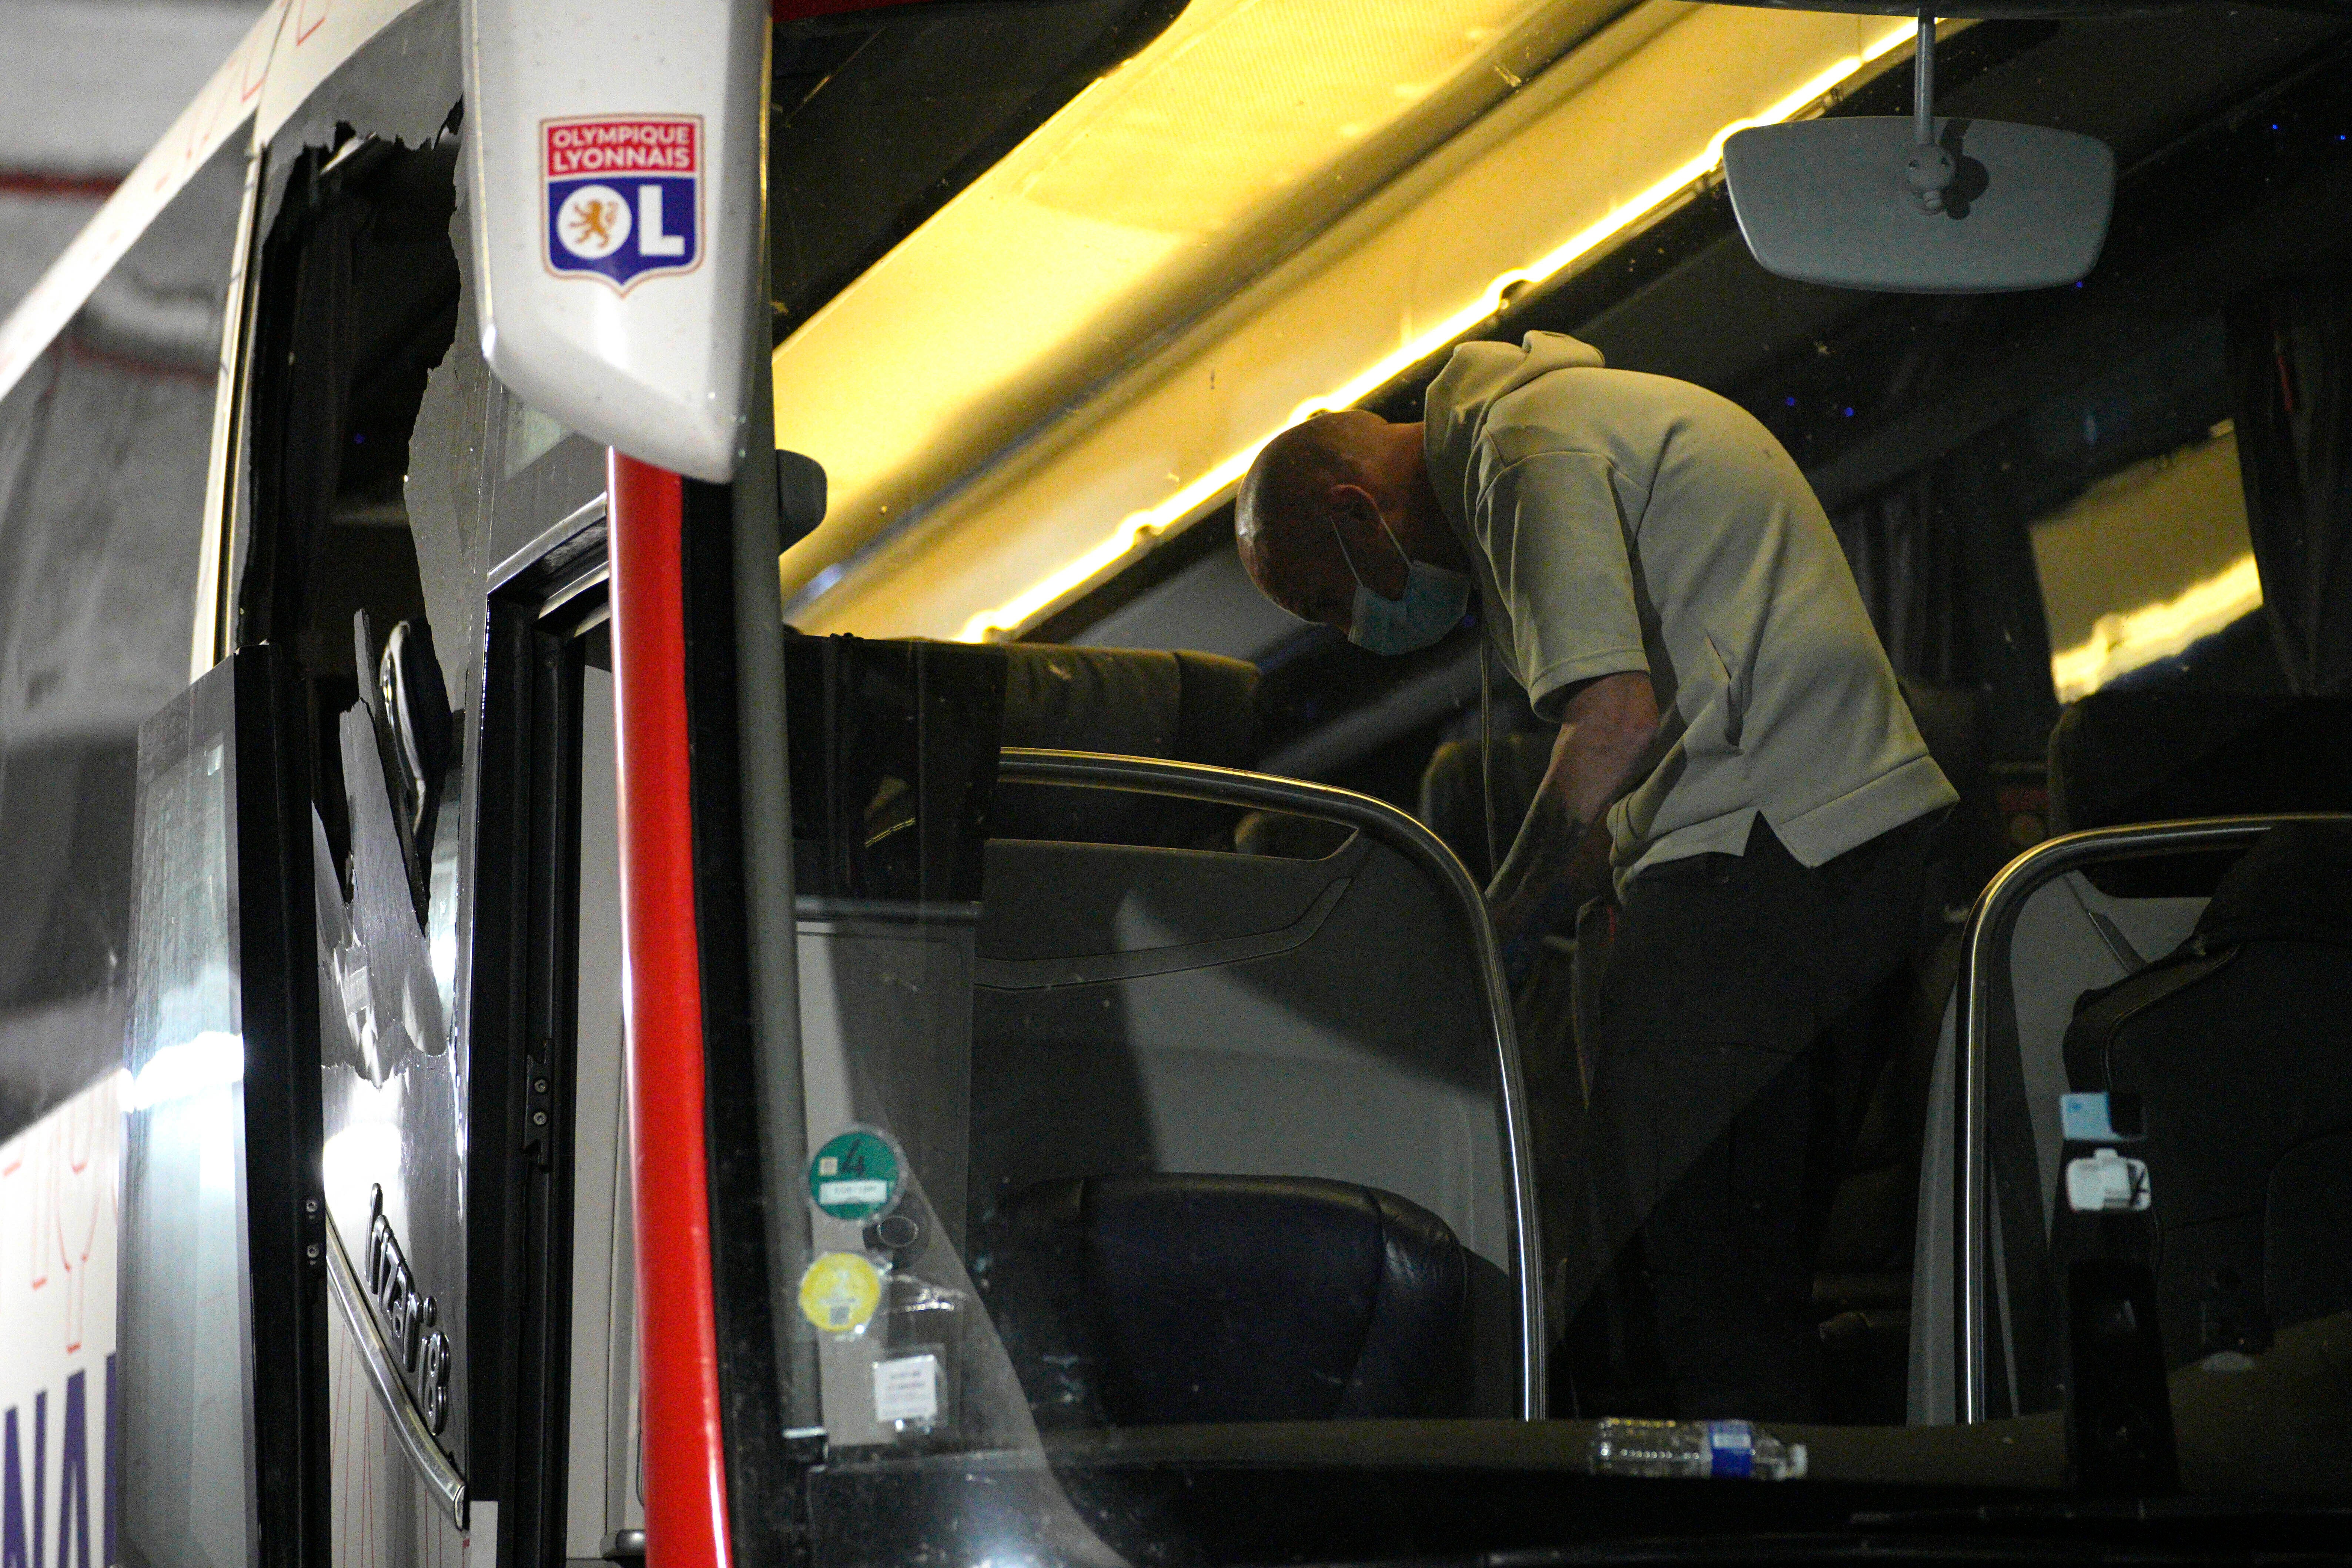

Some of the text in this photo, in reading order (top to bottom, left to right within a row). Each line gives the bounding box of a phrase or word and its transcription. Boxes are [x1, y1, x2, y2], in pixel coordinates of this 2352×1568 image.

[553, 125, 690, 148] OLYMPIQUE
[553, 147, 690, 171] LYONNAIS
[557, 184, 685, 259] OL
